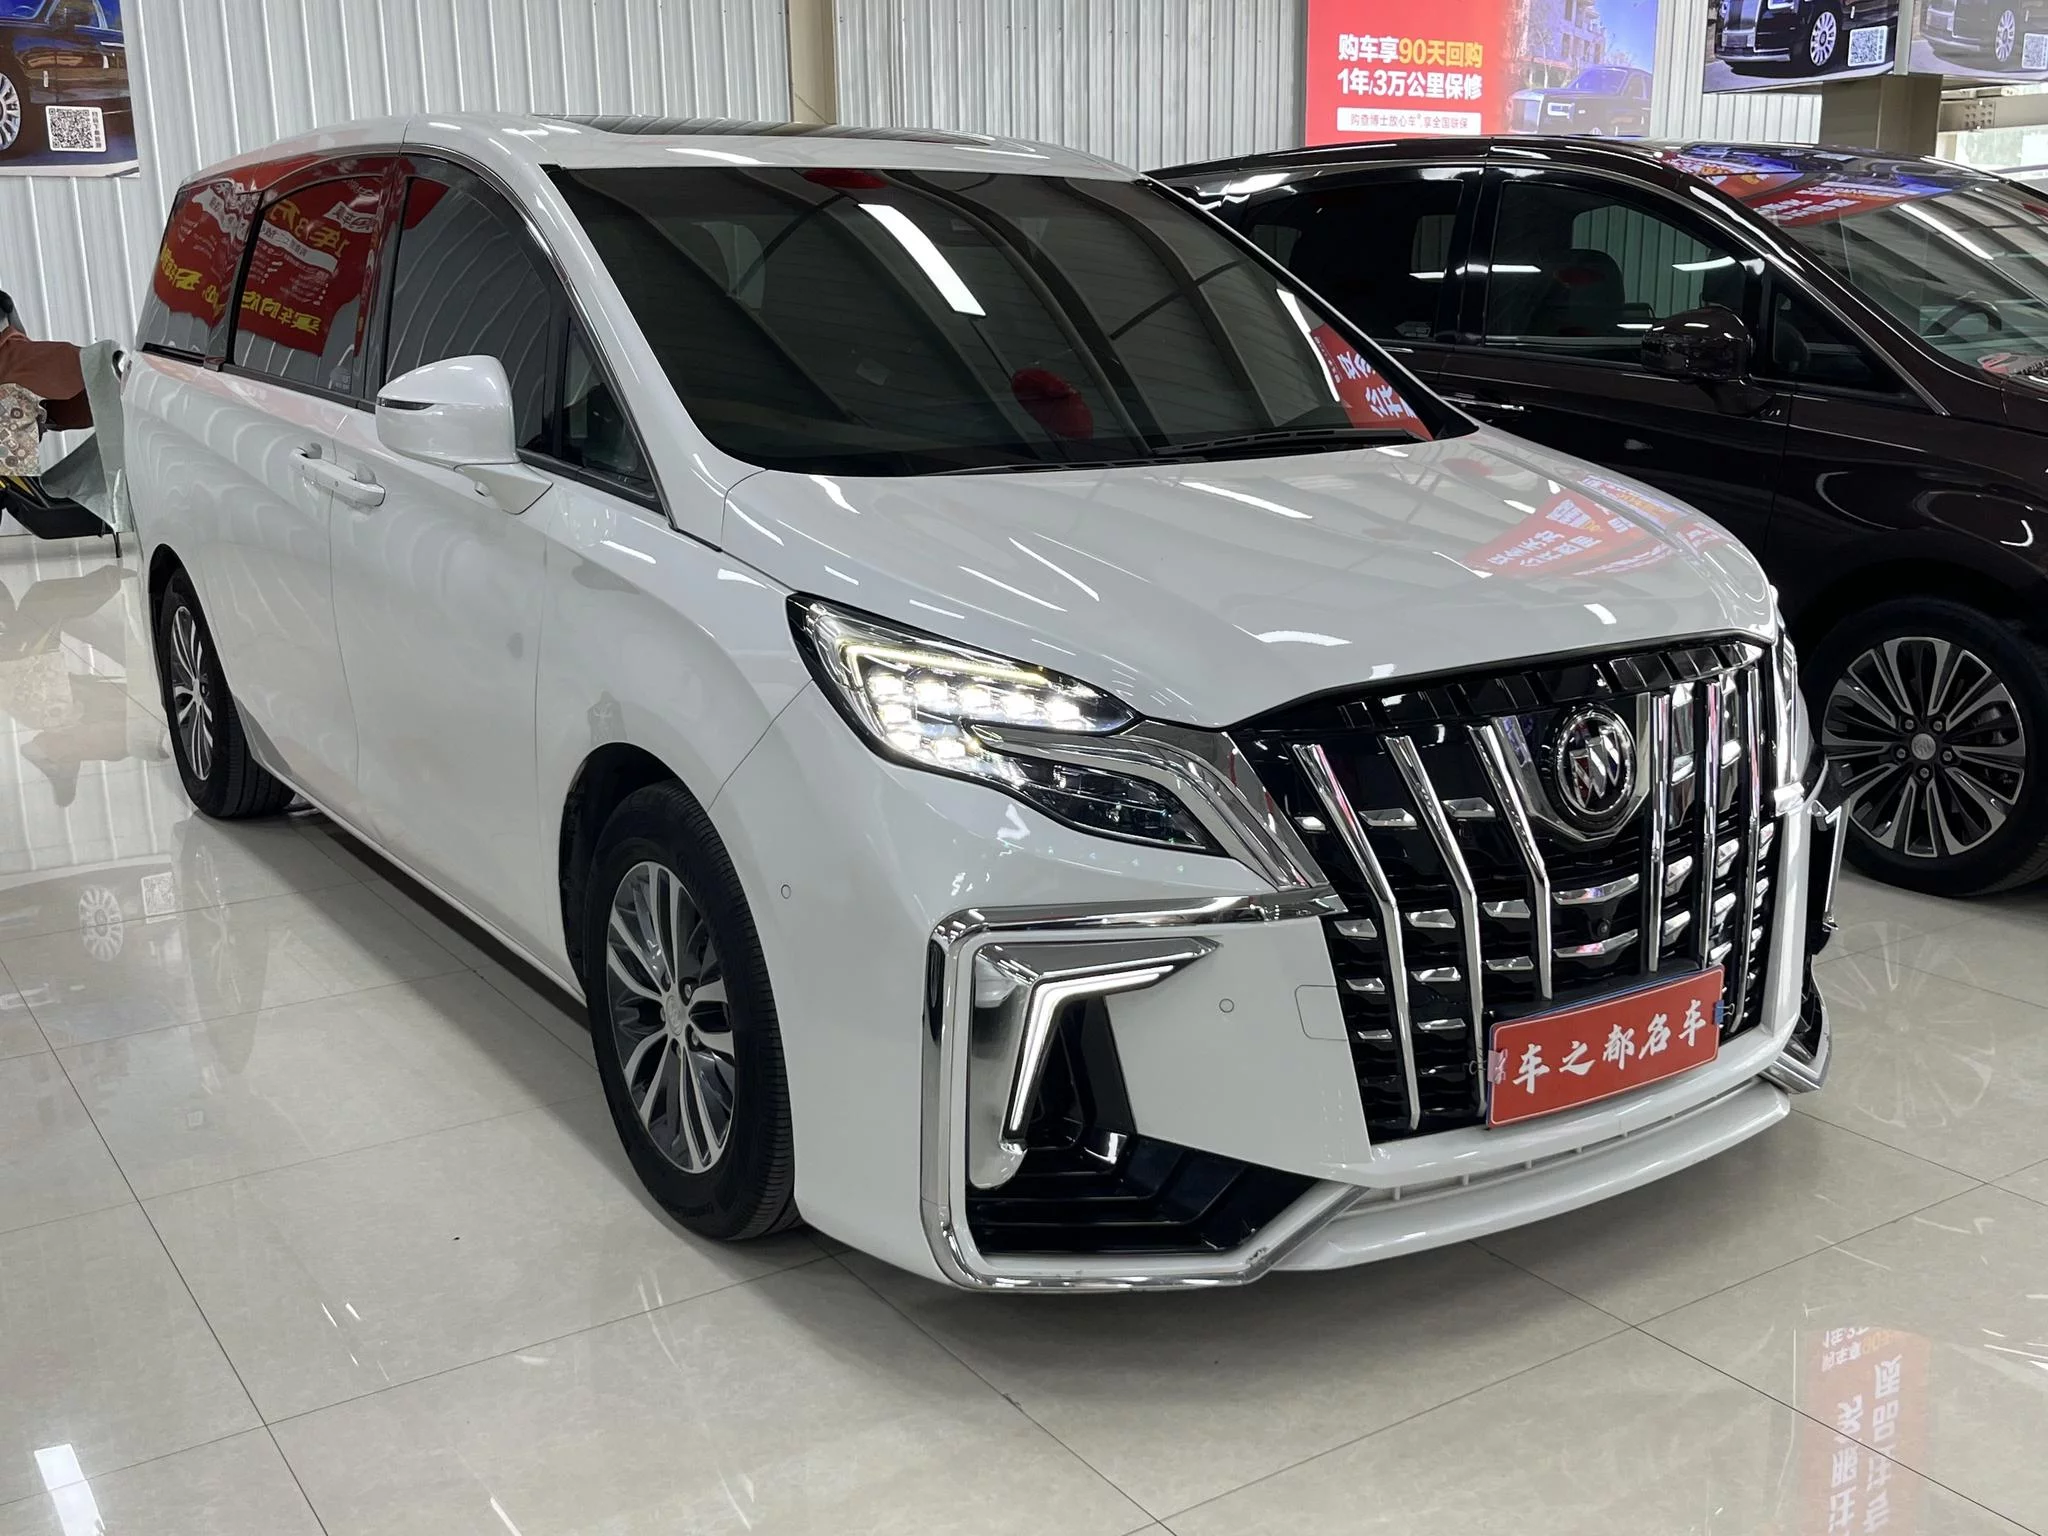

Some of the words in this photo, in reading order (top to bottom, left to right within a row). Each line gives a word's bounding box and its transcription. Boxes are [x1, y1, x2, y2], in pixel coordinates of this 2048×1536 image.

[1338, 33, 1483, 68] 购车享90天回购
[1512, 999, 1706, 1094] 车之都名车
